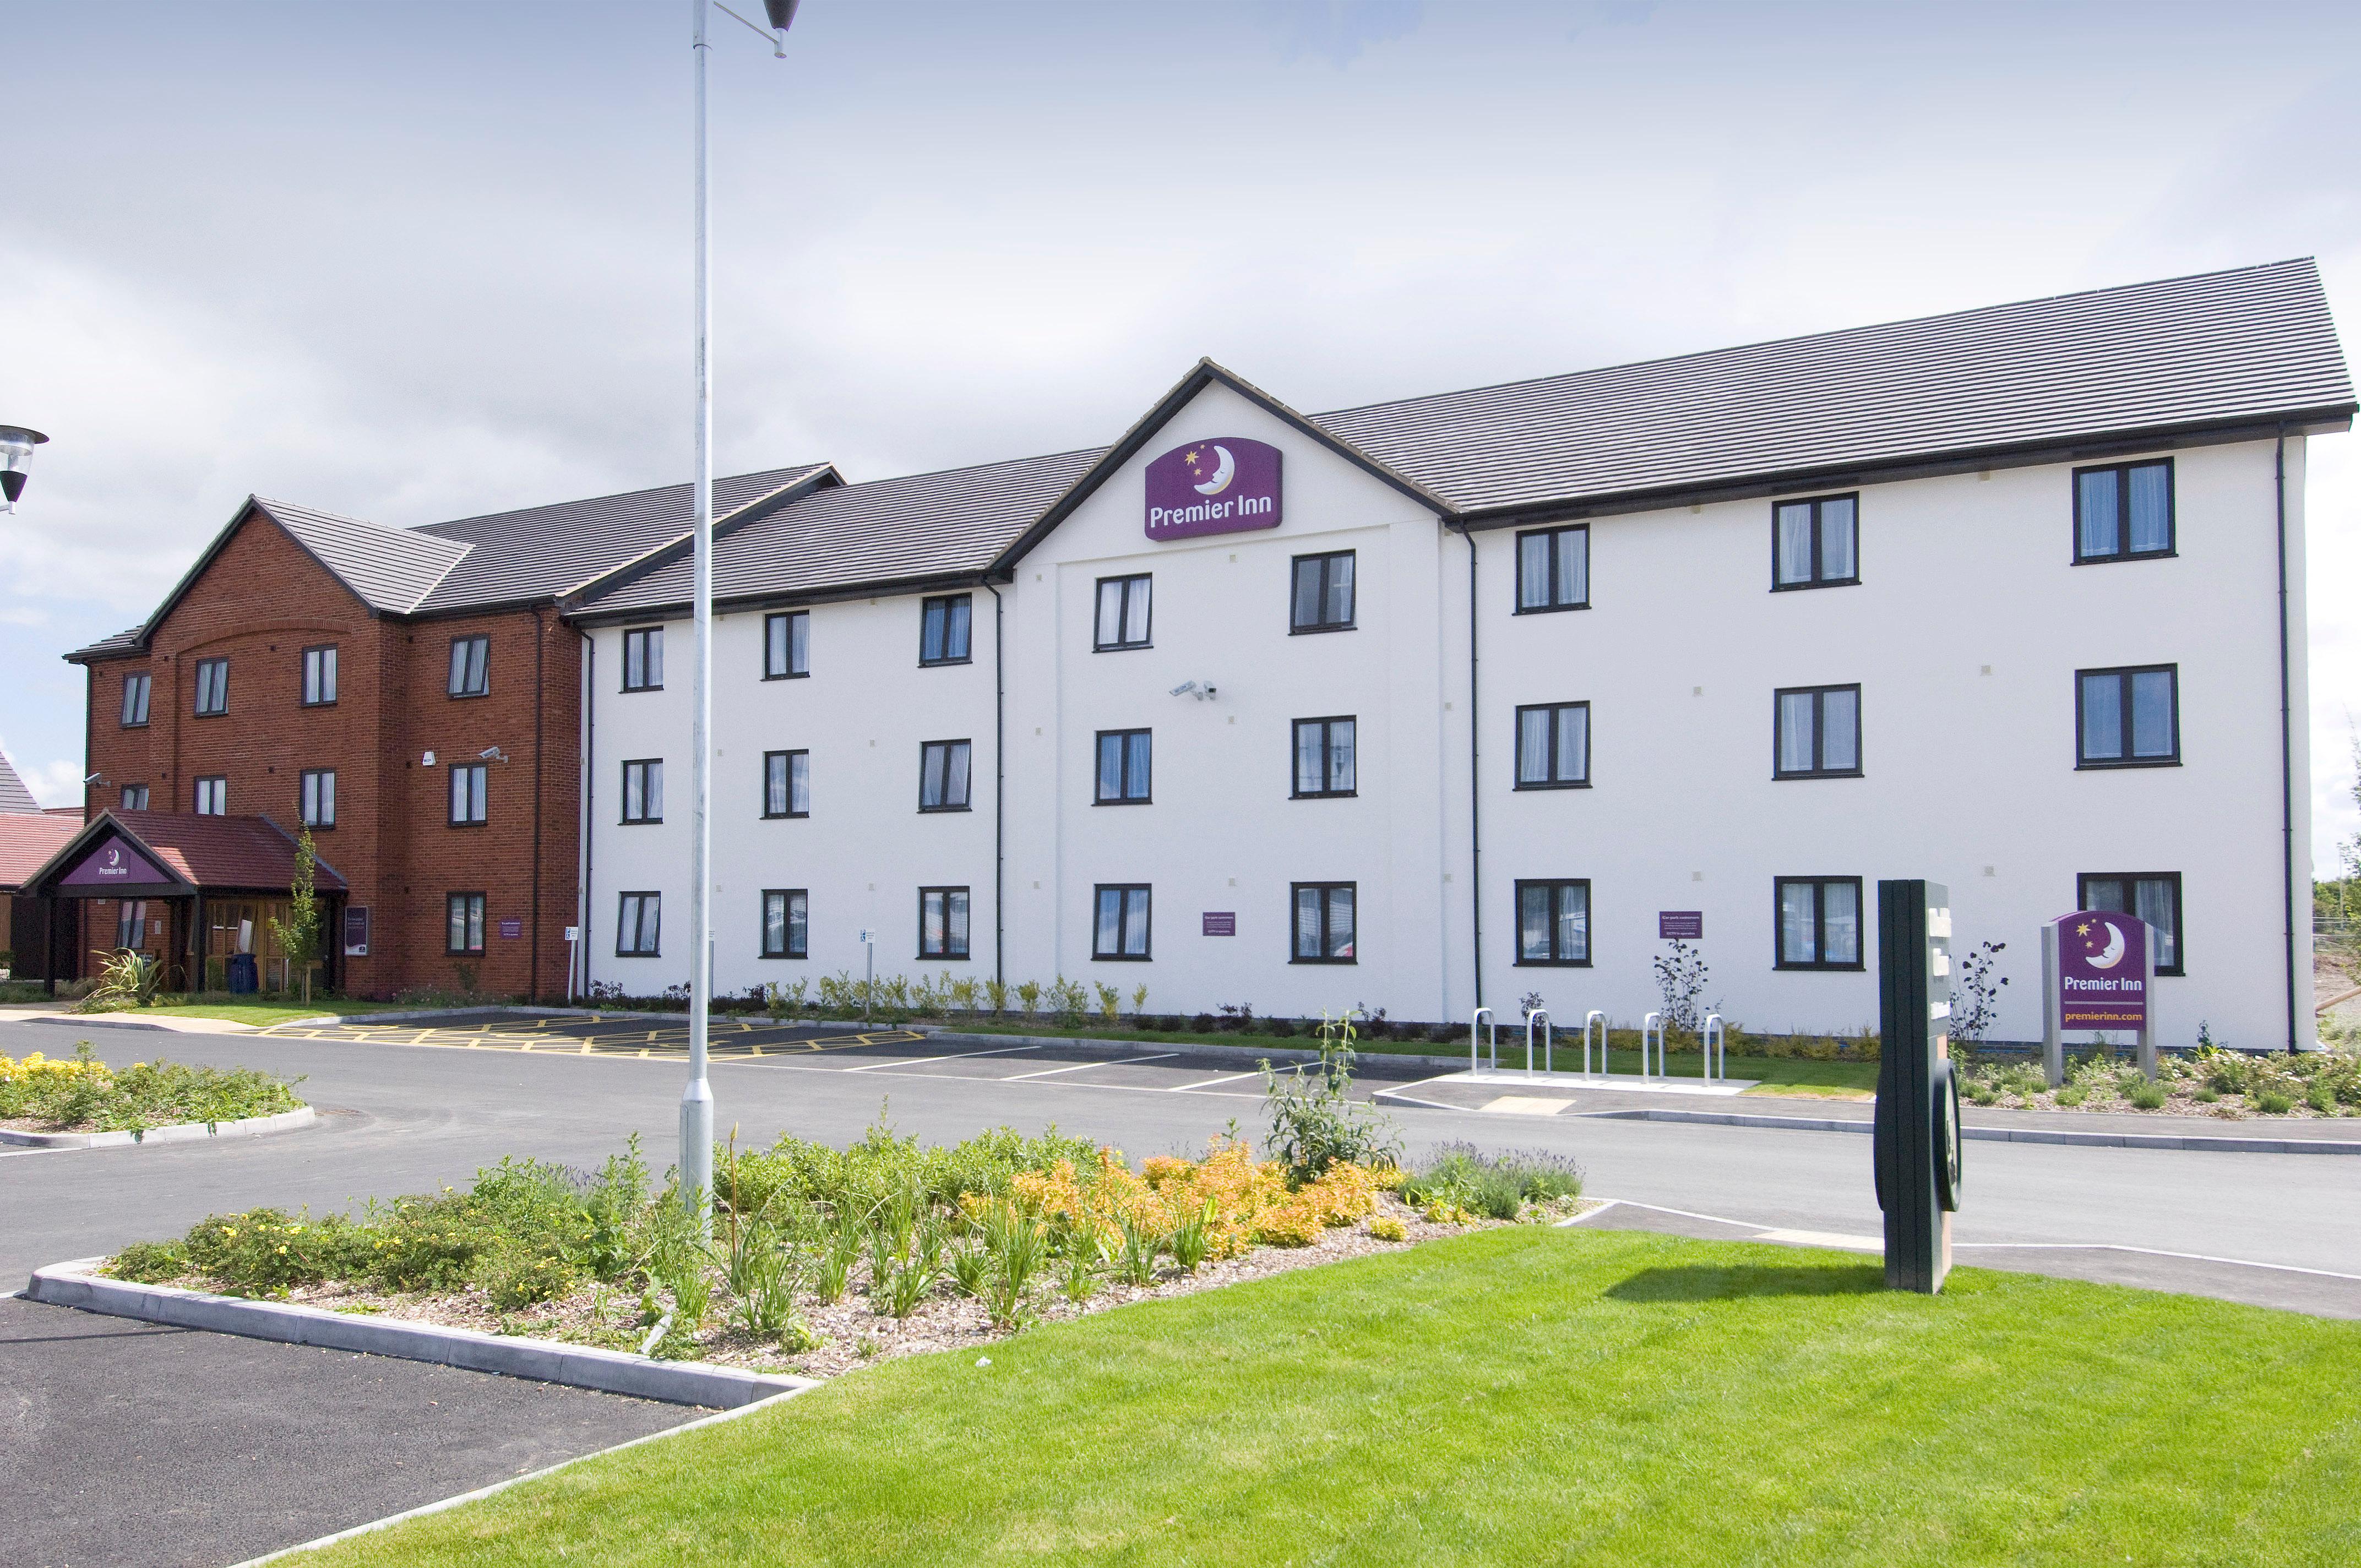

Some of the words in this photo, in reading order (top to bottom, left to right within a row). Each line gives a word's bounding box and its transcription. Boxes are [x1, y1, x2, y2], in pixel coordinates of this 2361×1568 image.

[1150, 499, 1233, 528] Premier
[1238, 495, 1271, 515] Inn
[2064, 976, 2119, 990] Premier
[2121, 977, 2142, 990] Inn
[2065, 1011, 2143, 1022] premierinn.com
